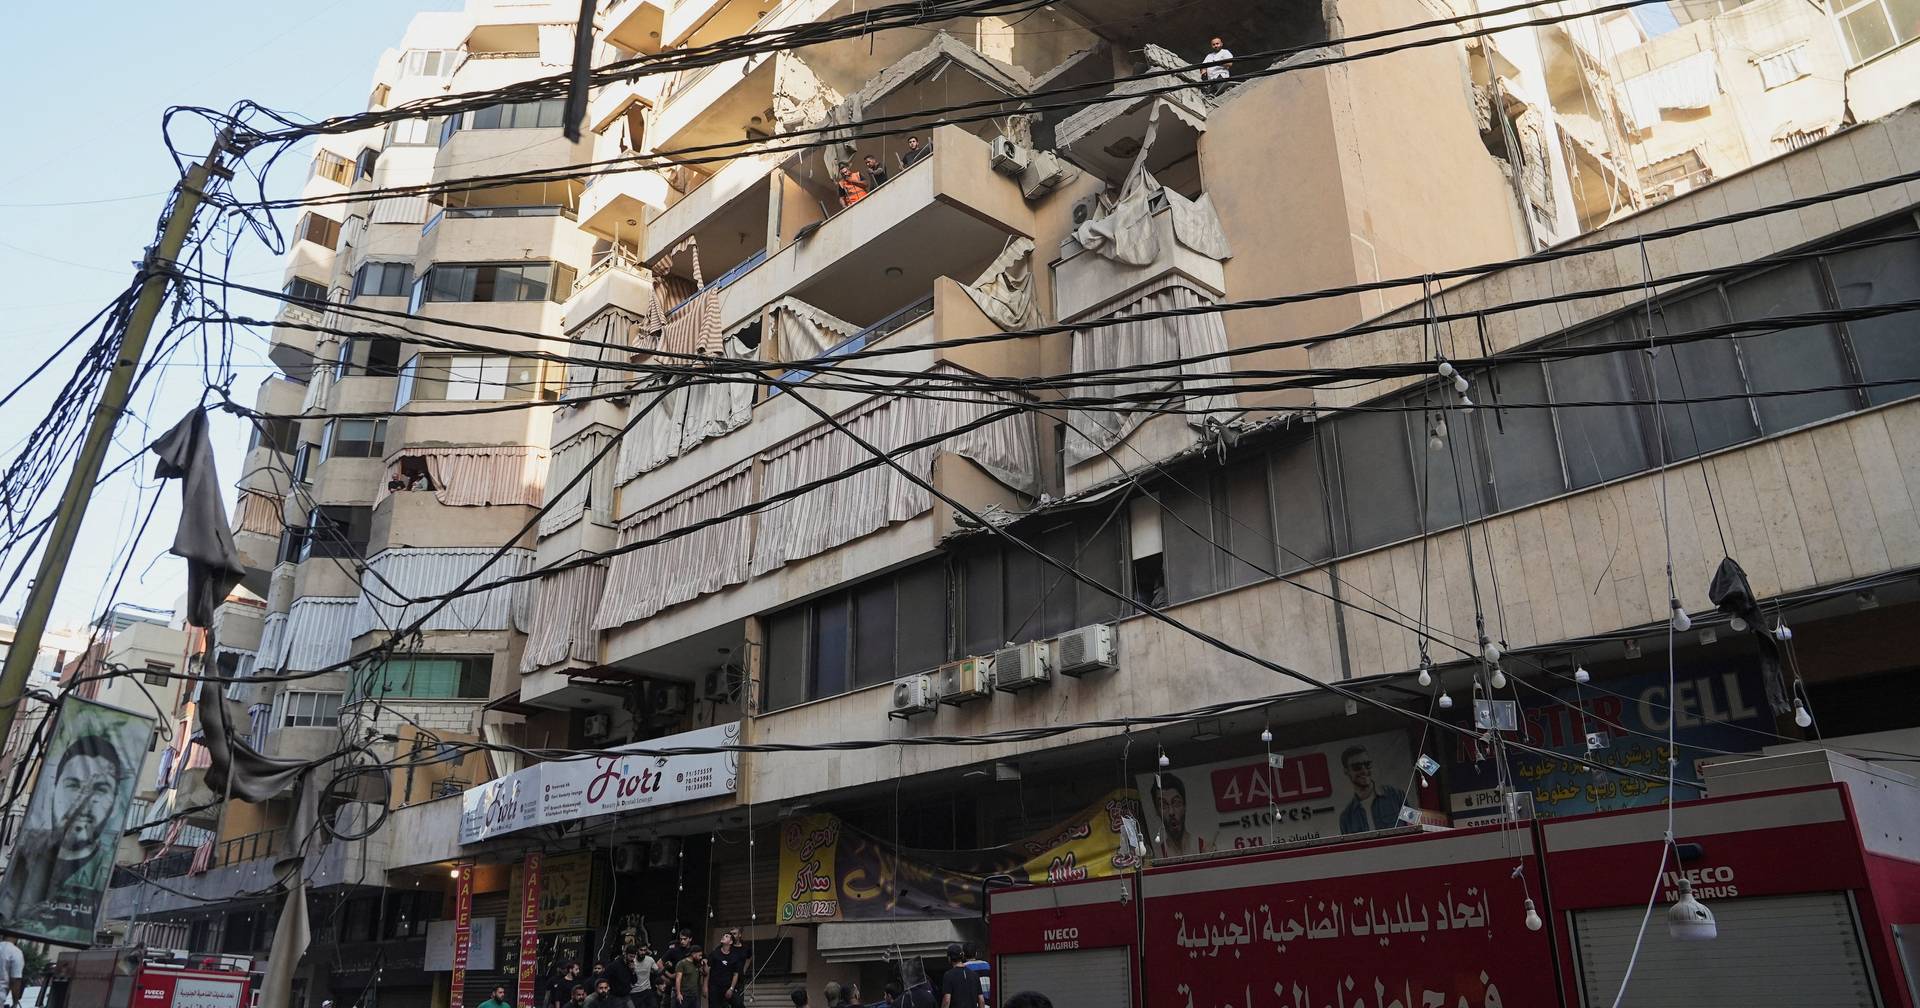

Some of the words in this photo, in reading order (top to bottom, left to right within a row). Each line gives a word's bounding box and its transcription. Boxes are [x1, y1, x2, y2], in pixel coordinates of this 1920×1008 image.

[1456, 695, 1628, 763] MSTER
[1639, 672, 1758, 733] CELL
[586, 754, 662, 804] Fiori
[1222, 759, 1324, 805] 4ALL
[1519, 759, 1555, 780] خلوية
[1535, 780, 1581, 805] خطوط
[1239, 806, 1313, 829] stores
[460, 868, 471, 926] SALE
[527, 856, 540, 919] SALE
[1663, 866, 1734, 888] IVECO
[1665, 885, 1738, 902] MGIRUS
[1044, 928, 1079, 941] IVECO
[1175, 905, 1259, 960] الجنوبية
[1260, 899, 1346, 954] الضاحية
[1351, 890, 1429, 947] بلديات
[1436, 887, 1493, 940] إتحاد
[1044, 940, 1079, 951] MAGIRUS
